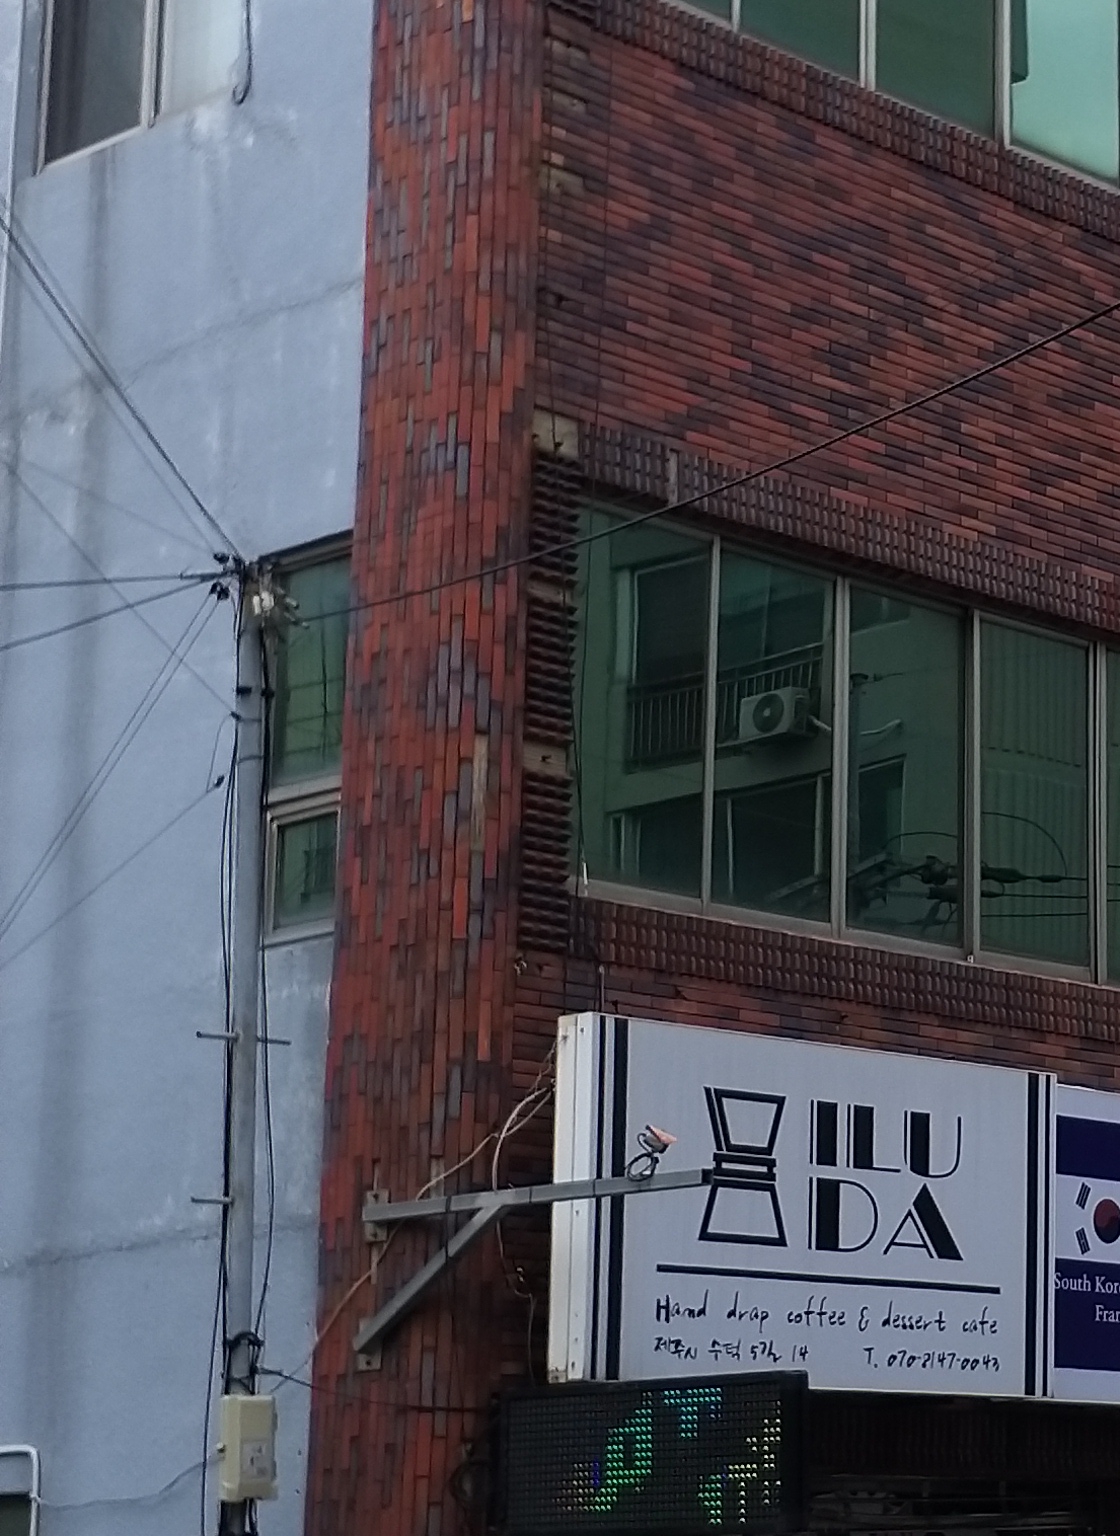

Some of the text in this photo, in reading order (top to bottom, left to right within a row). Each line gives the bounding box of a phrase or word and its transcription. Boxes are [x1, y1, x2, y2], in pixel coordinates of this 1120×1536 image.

[808, 1175, 964, 1262] DA
[1054, 1272, 1091, 1293] South
[656, 1289, 710, 1324] Hand
[787, 1295, 846, 1327] coffee
[881, 1300, 947, 1333] dessert
[962, 1306, 998, 1336] cafe
[792, 1345, 809, 1363] 14
